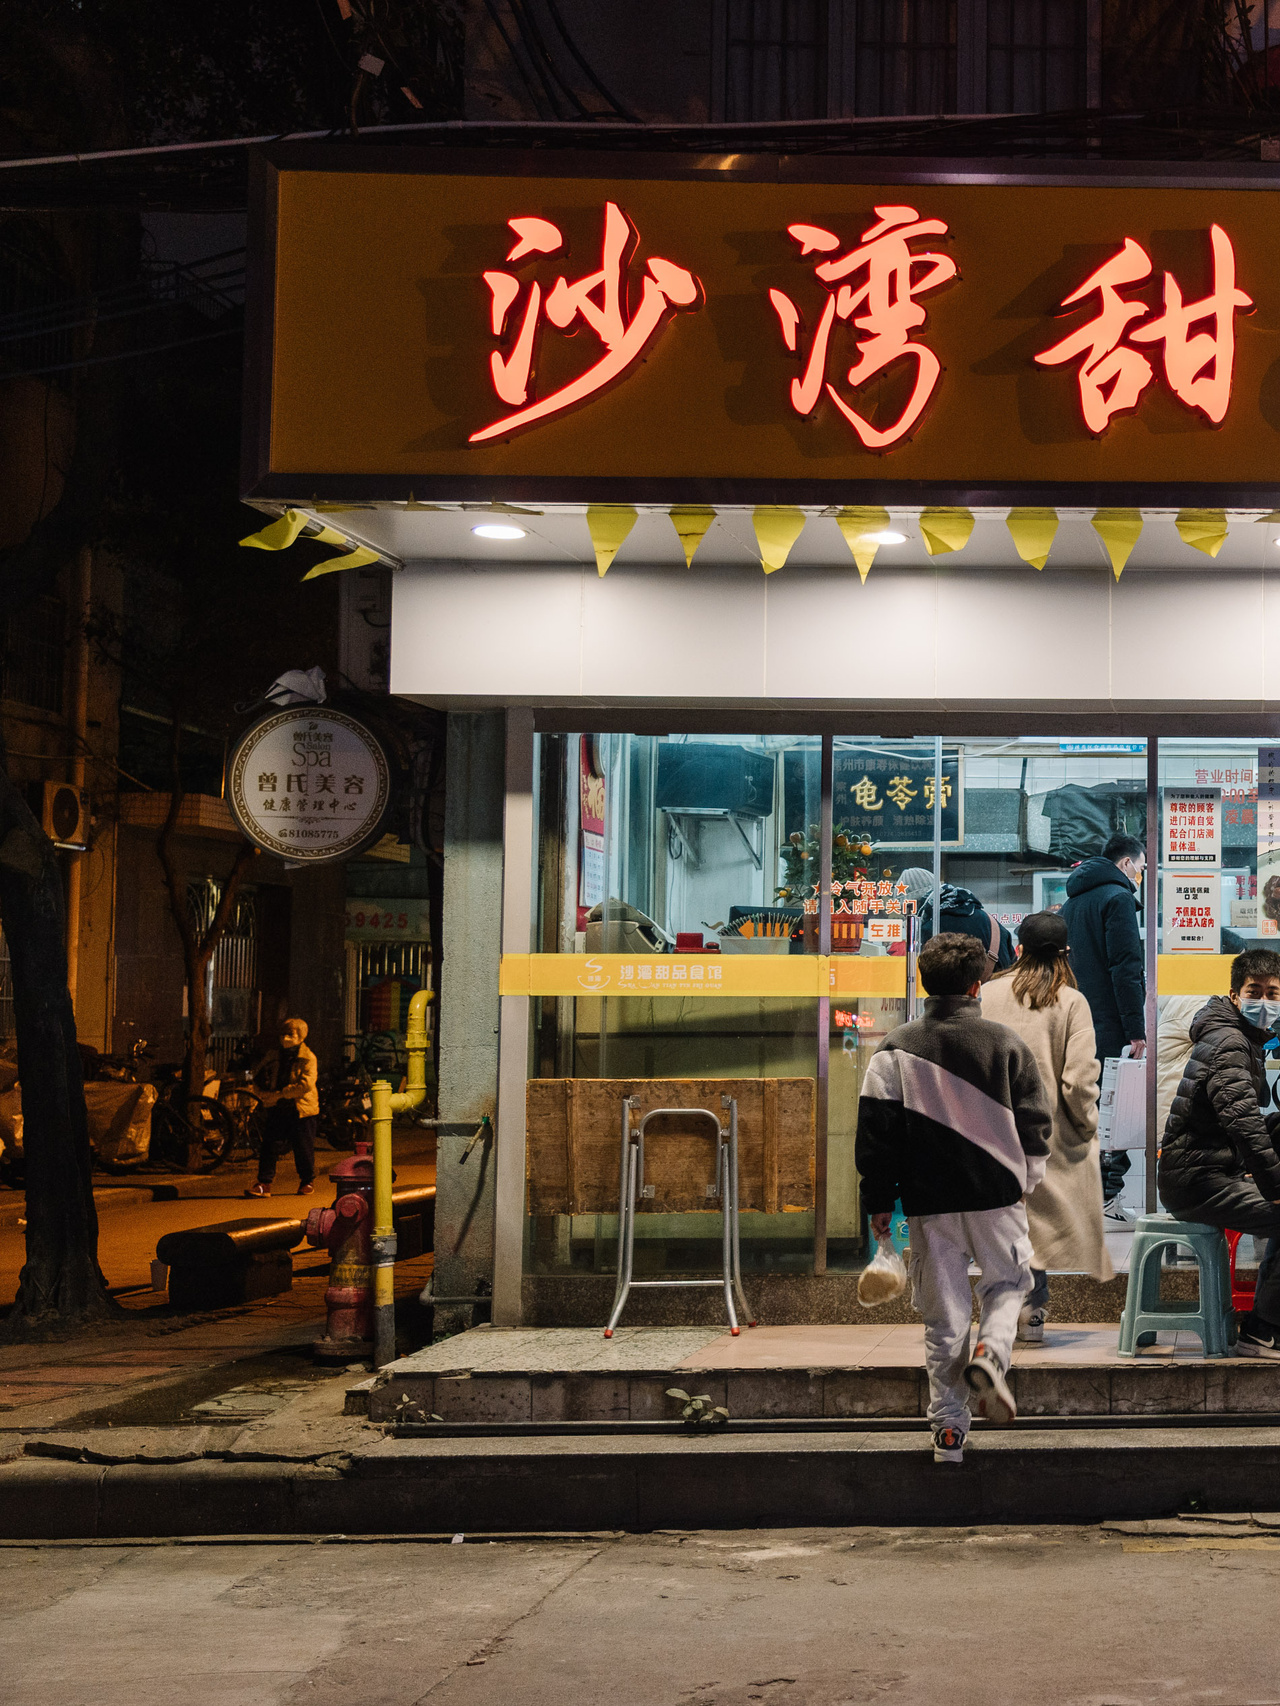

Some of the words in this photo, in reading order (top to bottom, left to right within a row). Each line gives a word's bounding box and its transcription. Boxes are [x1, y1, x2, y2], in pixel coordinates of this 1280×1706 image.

[291, 744, 331, 768] Spa
[258, 773, 364, 795] 曾氏美容
[850, 775, 952, 811] 龟苓膏
[263, 798, 357, 812] 健康管理中心
[1170, 803, 1214, 813] 尊敬的顾客
[1170, 816, 1214, 826] 进门请自觉
[289, 829, 339, 839] 81085775
[1170, 829, 1214, 839] 配合门店测
[803, 899, 917, 915] 请入随手关门
[1175, 907, 1211, 917] 不佩戴口罩
[870, 923, 901, 938] 左推
[620, 965, 722, 980] 沙湾甜品食馆
